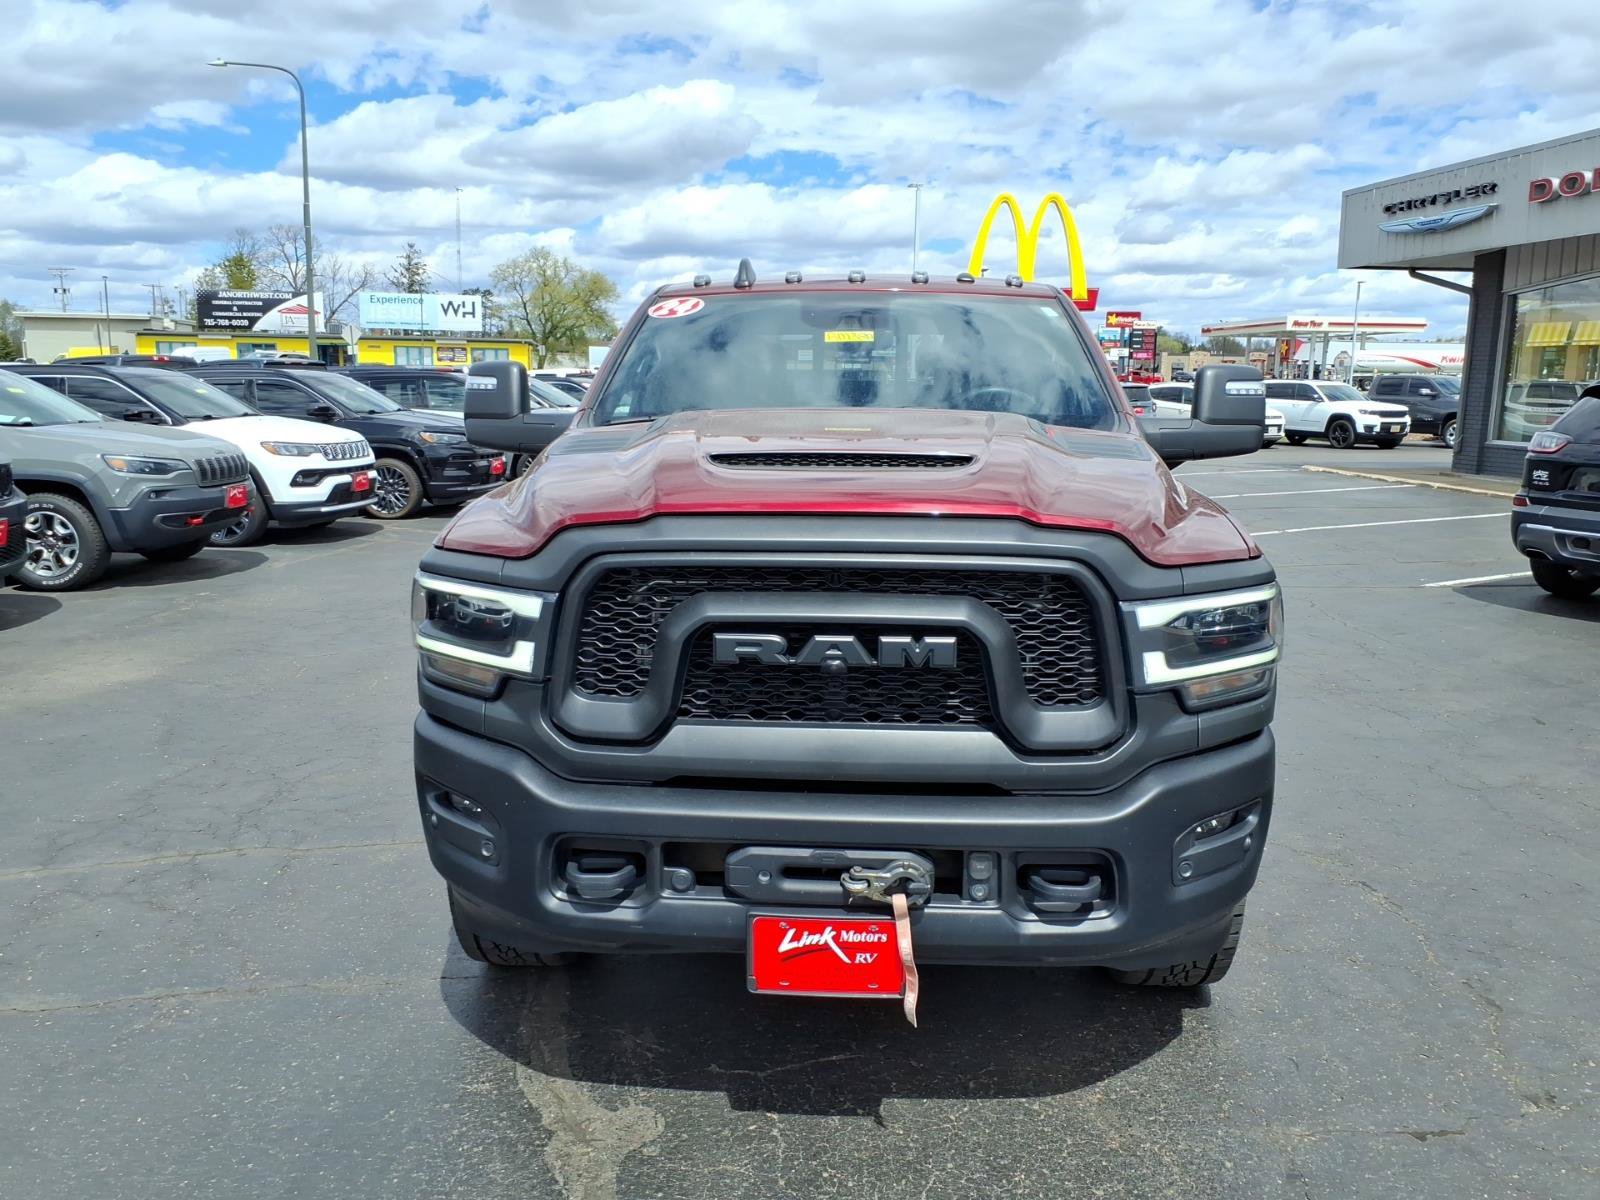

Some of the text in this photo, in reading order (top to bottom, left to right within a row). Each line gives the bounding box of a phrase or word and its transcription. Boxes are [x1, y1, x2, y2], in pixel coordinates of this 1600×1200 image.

[370, 294, 424, 305] Experience
[713, 633, 957, 668] RAM
[777, 926, 888, 964] Link Motors
[854, 953, 878, 964] RV
